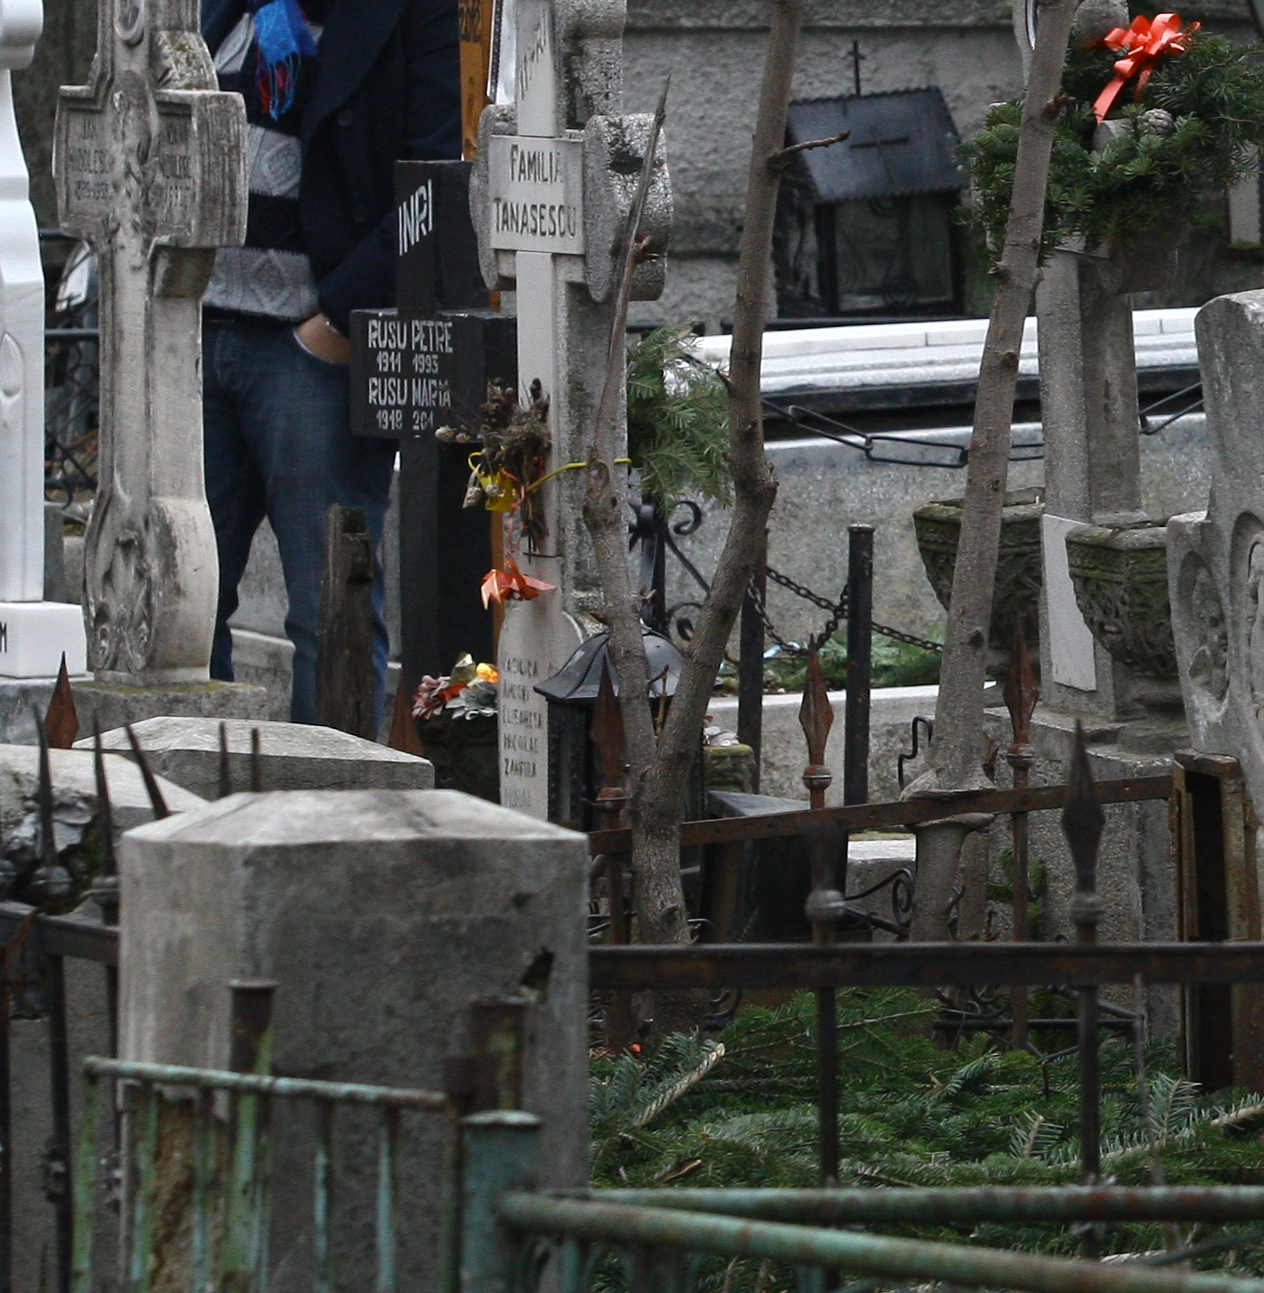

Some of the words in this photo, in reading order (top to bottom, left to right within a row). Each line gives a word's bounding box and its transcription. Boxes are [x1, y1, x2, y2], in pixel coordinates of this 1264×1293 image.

[510, 144, 563, 184] FAMILIA
[398, 179, 433, 256] INRI
[368, 319, 407, 350] RUSU
[411, 320, 453, 354] PETRE
[368, 377, 407, 406] RUSU
[411, 379, 451, 408] MARIA
